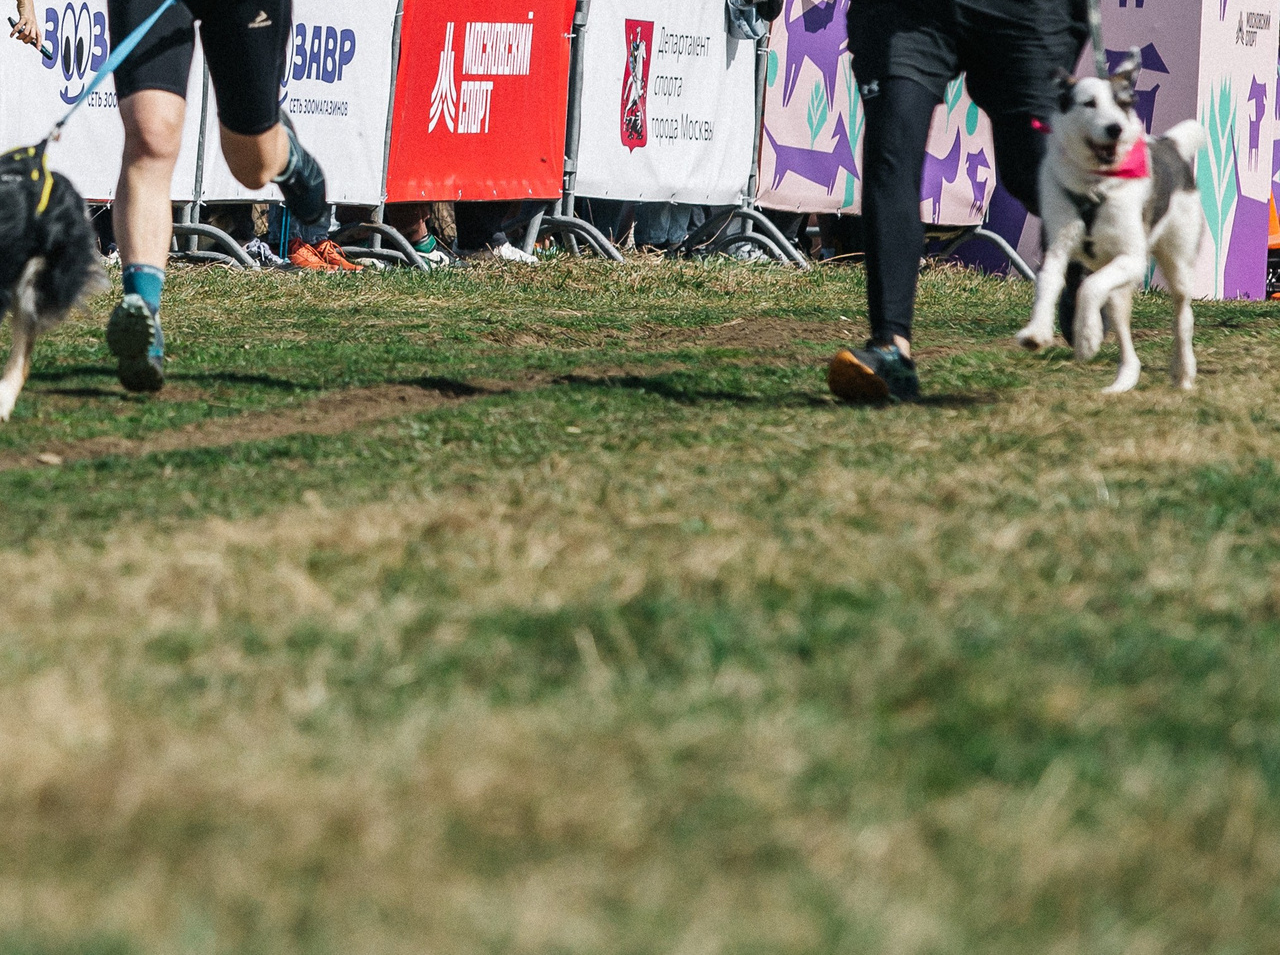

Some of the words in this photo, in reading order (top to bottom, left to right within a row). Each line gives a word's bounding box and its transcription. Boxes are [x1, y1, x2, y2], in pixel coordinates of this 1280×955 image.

[292, 22, 356, 84] ЗАВР
[462, 11, 534, 76] МОСКОВСКИЙ
[657, 26, 710, 63] Департамент
[289, 98, 303, 114] СЕТЬ
[303, 98, 348, 117] ЗООМАГАЗИНОВ
[457, 80, 494, 134] СПОРТ
[654, 75, 682, 105] спорта
[652, 117, 679, 147] города
[681, 113, 715, 141] Москвы
